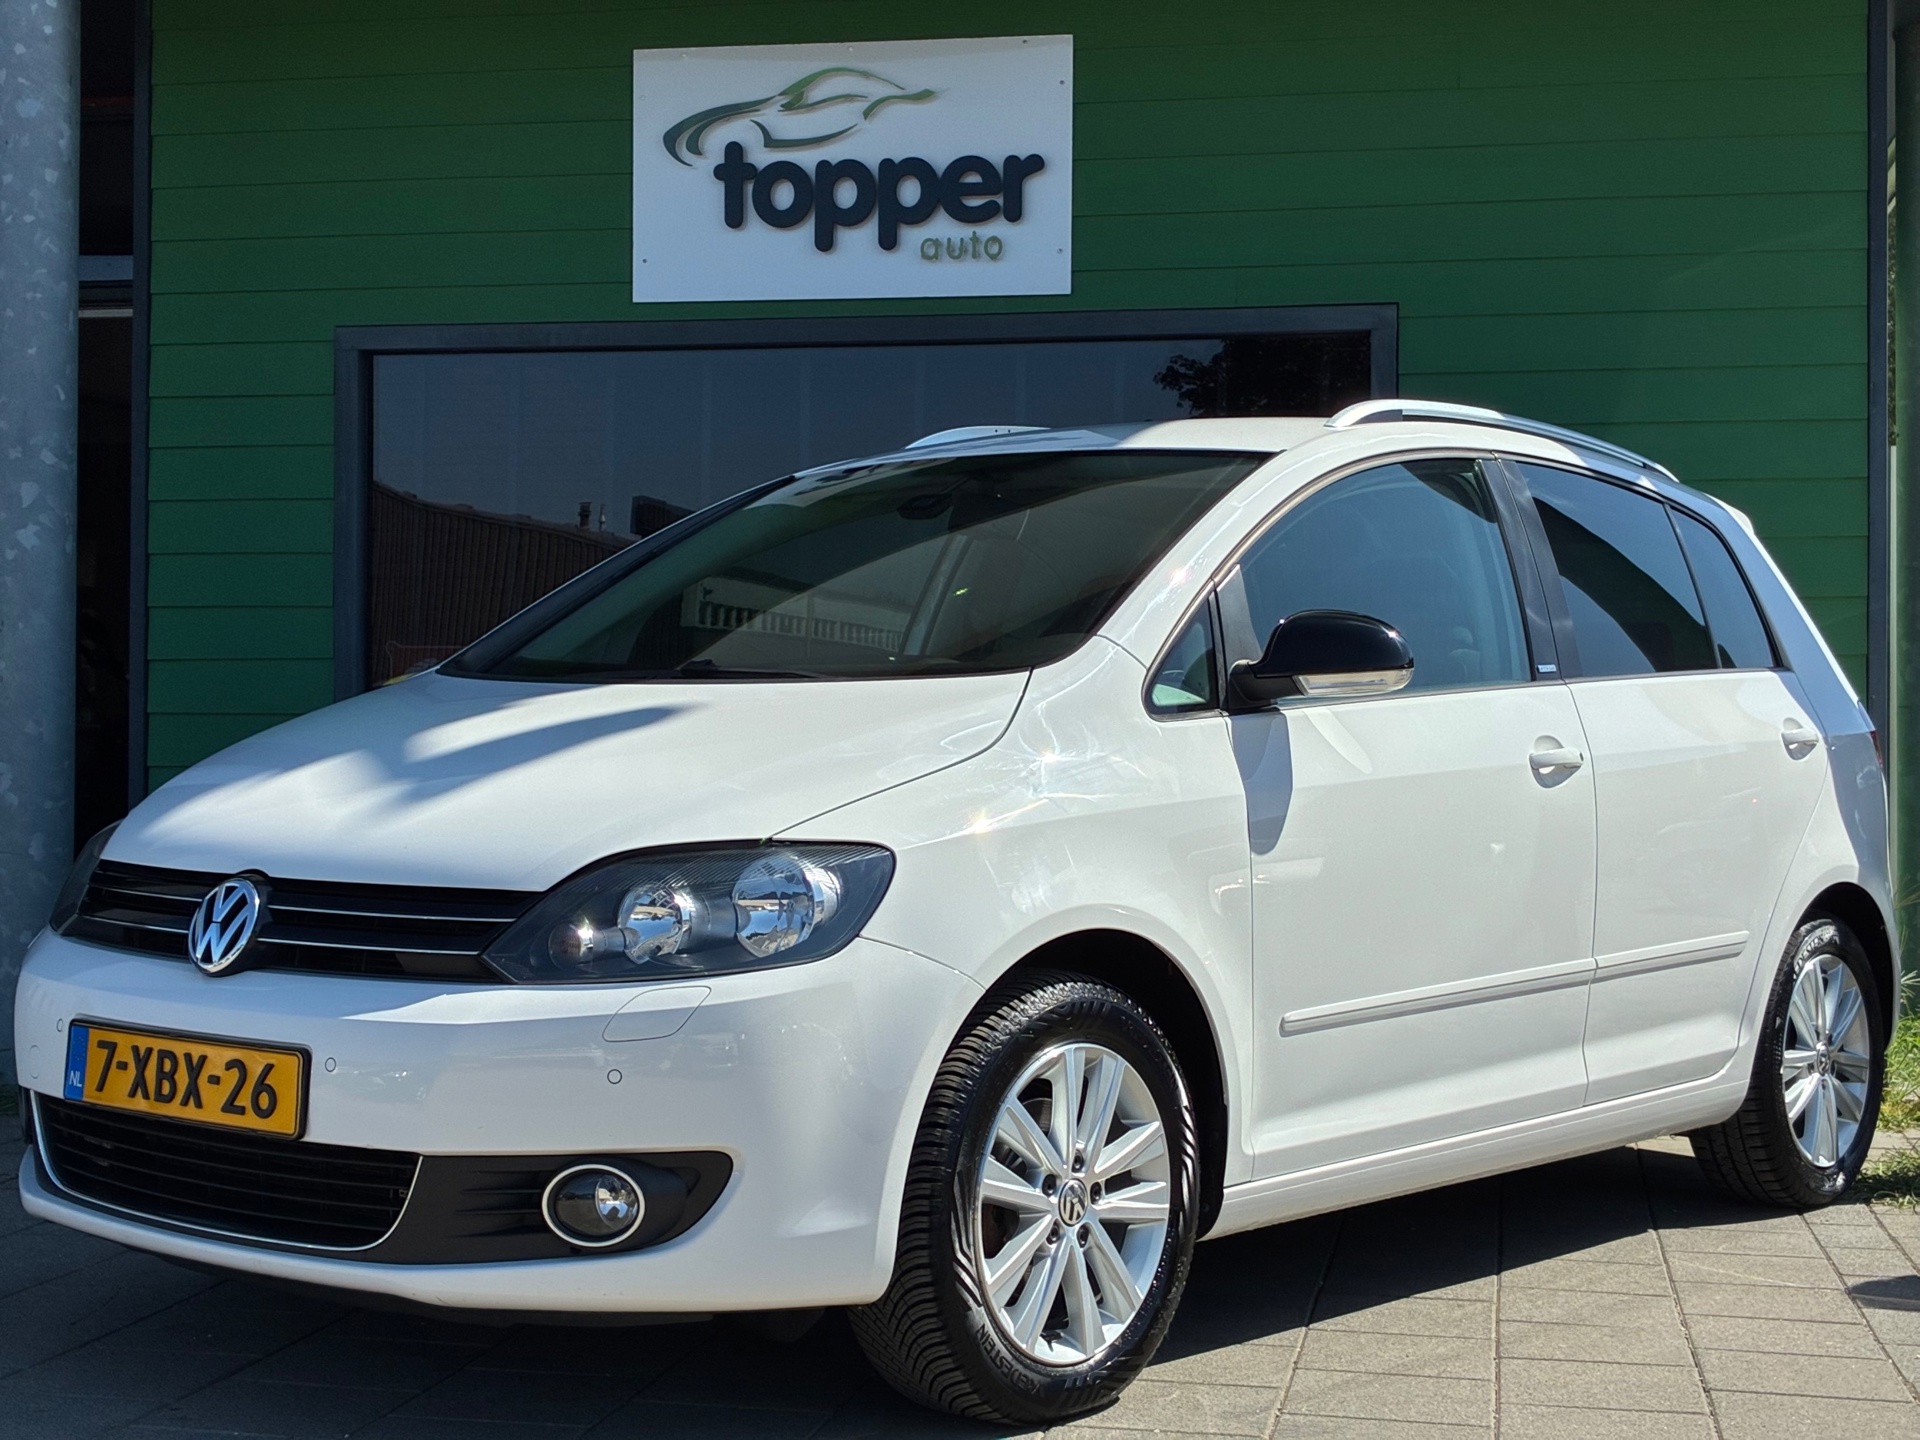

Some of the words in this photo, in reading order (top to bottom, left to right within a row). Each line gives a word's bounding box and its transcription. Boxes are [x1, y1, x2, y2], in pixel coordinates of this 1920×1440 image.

[713, 141, 1045, 252] topper
[920, 230, 1003, 261] auto
[68, 1070, 83, 1088] NL
[96, 1039, 278, 1119] 7-XBX-26
